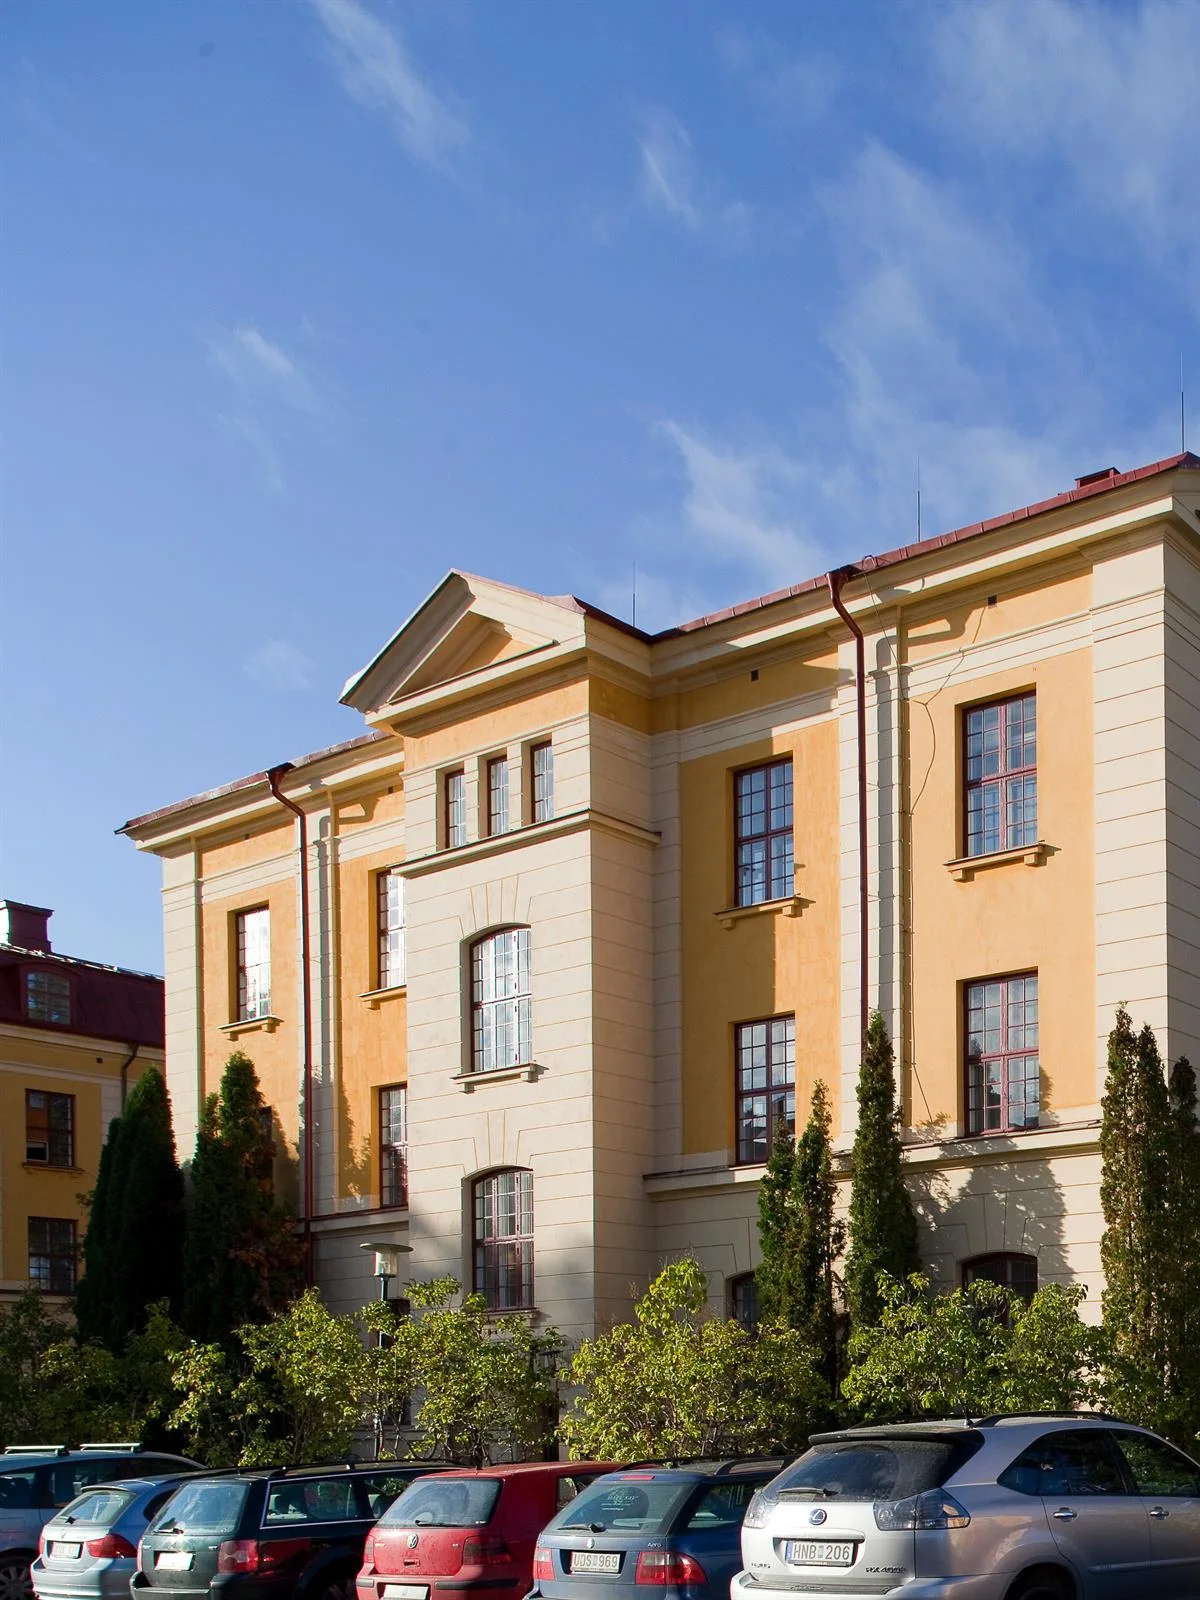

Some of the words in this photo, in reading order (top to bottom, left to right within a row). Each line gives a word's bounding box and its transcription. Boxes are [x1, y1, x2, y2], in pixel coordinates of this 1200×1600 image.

[573, 1553, 592, 1567] UDS
[598, 1555, 618, 1568] 969
[793, 1544, 817, 1560] HNB
[825, 1545, 850, 1561] 206
